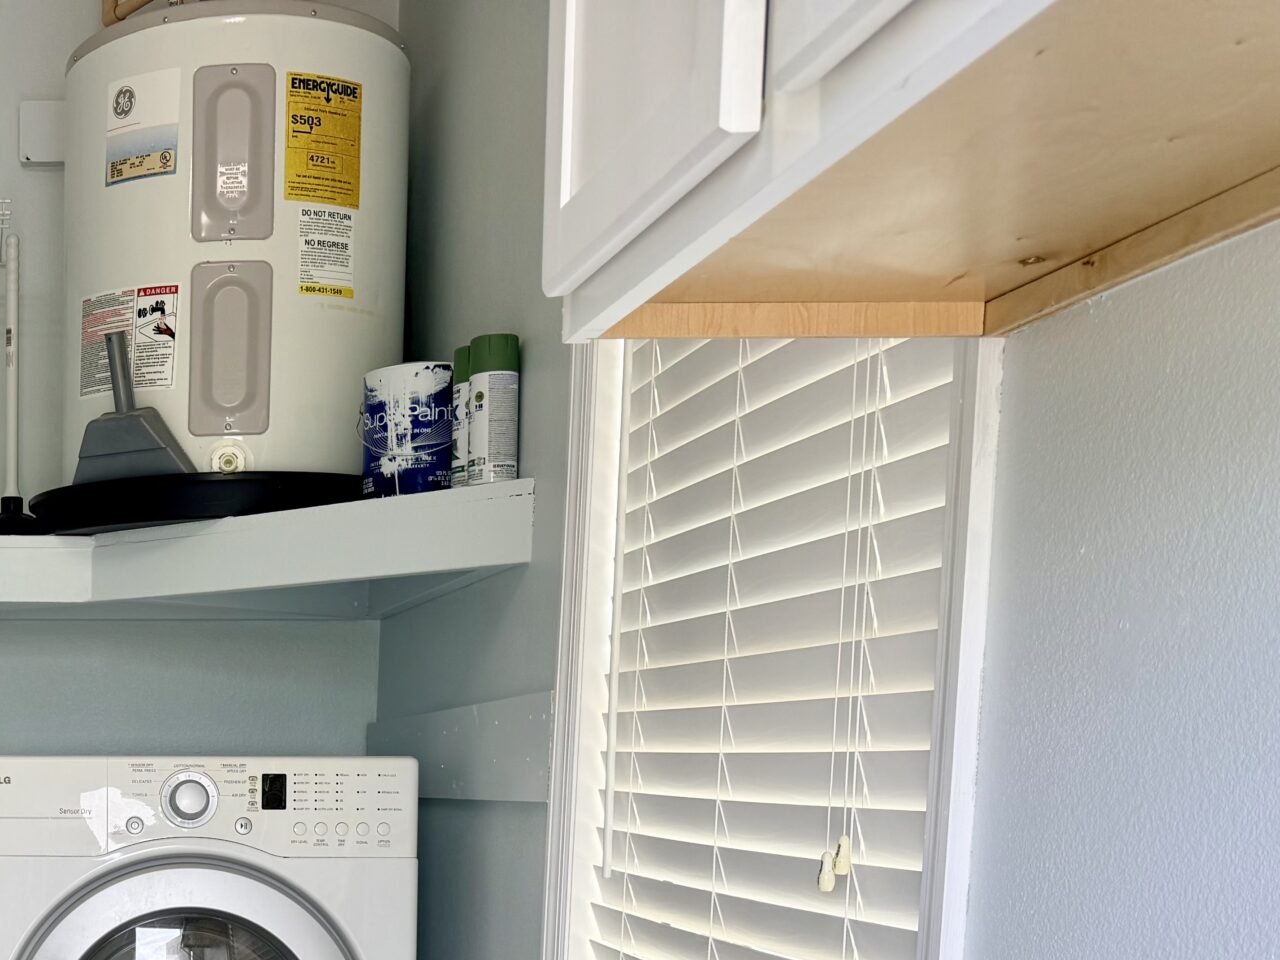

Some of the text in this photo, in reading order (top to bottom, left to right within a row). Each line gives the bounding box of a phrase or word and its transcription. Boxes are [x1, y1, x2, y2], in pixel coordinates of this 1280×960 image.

[291, 77, 358, 104] ENERGYGUIDE
[309, 155, 330, 164] 4721
[301, 209, 352, 221] DO NOT RETURN
[317, 239, 349, 250] REGRESE
[146, 286, 176, 295] DANGER
[81, 808, 92, 816] Dry
